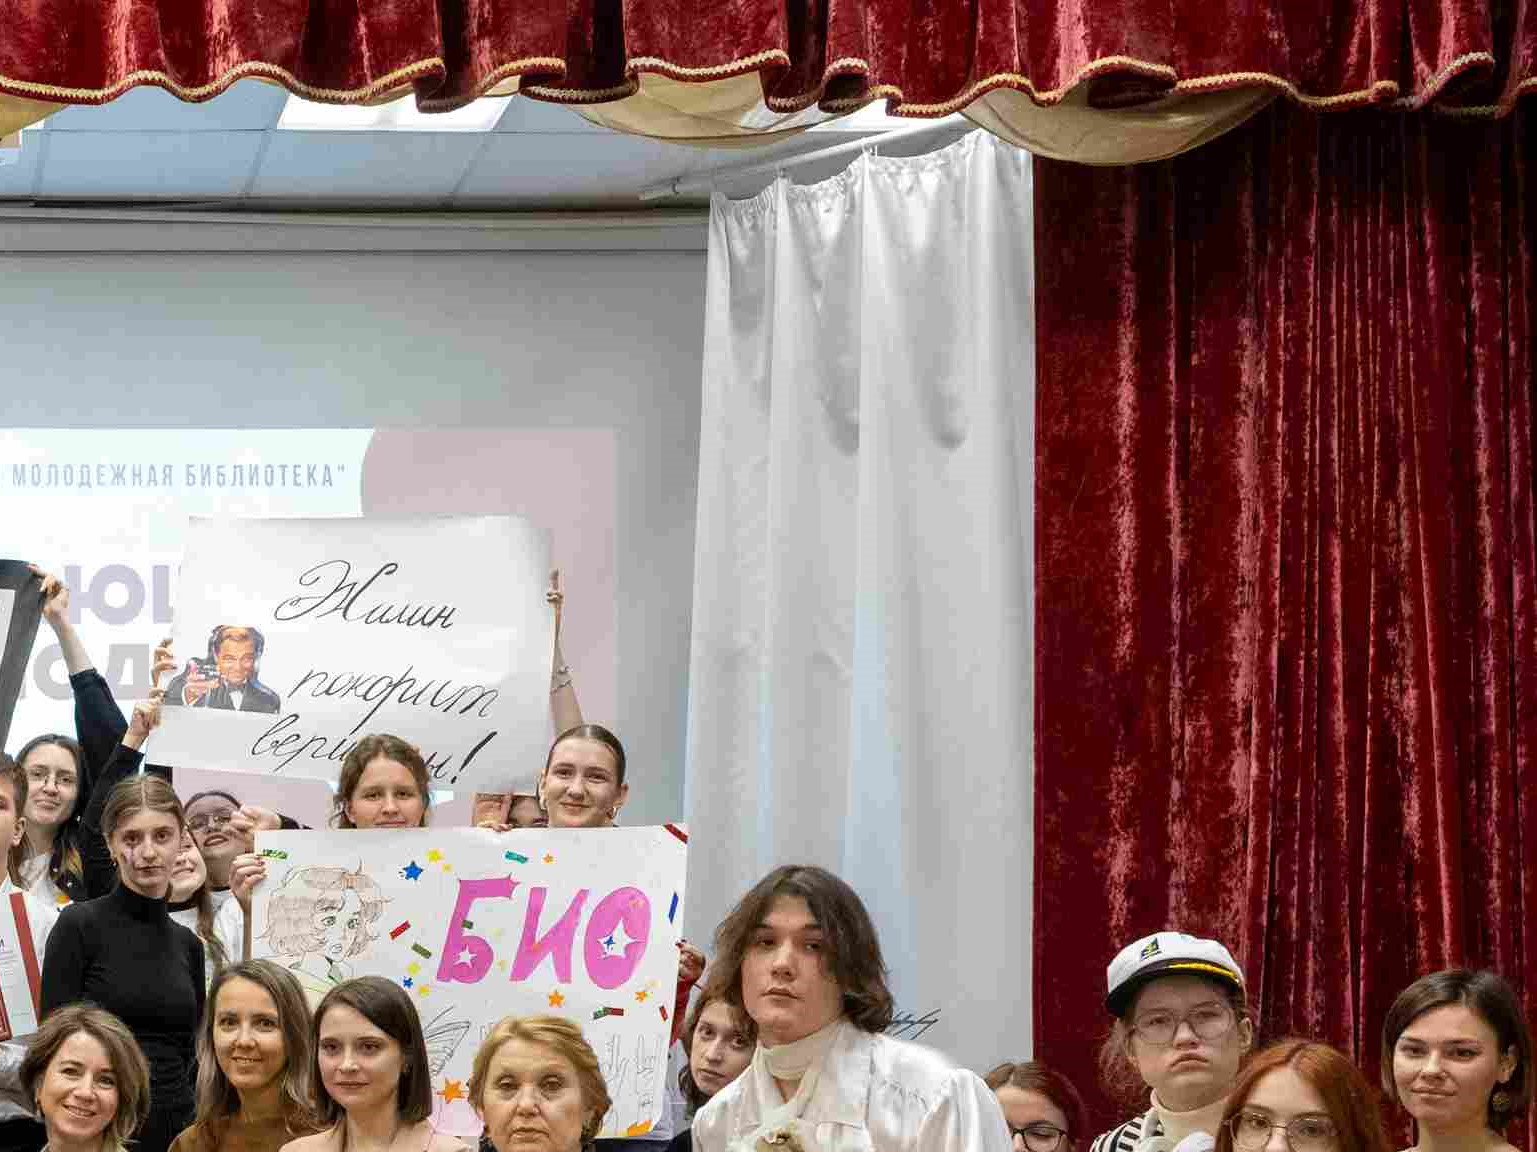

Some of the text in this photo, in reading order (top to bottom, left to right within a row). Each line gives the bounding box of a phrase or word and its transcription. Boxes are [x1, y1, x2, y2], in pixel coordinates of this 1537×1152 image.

[274, 559, 457, 629] Жилин
[287, 664, 499, 735] покорит
[436, 873, 652, 990] БИО
